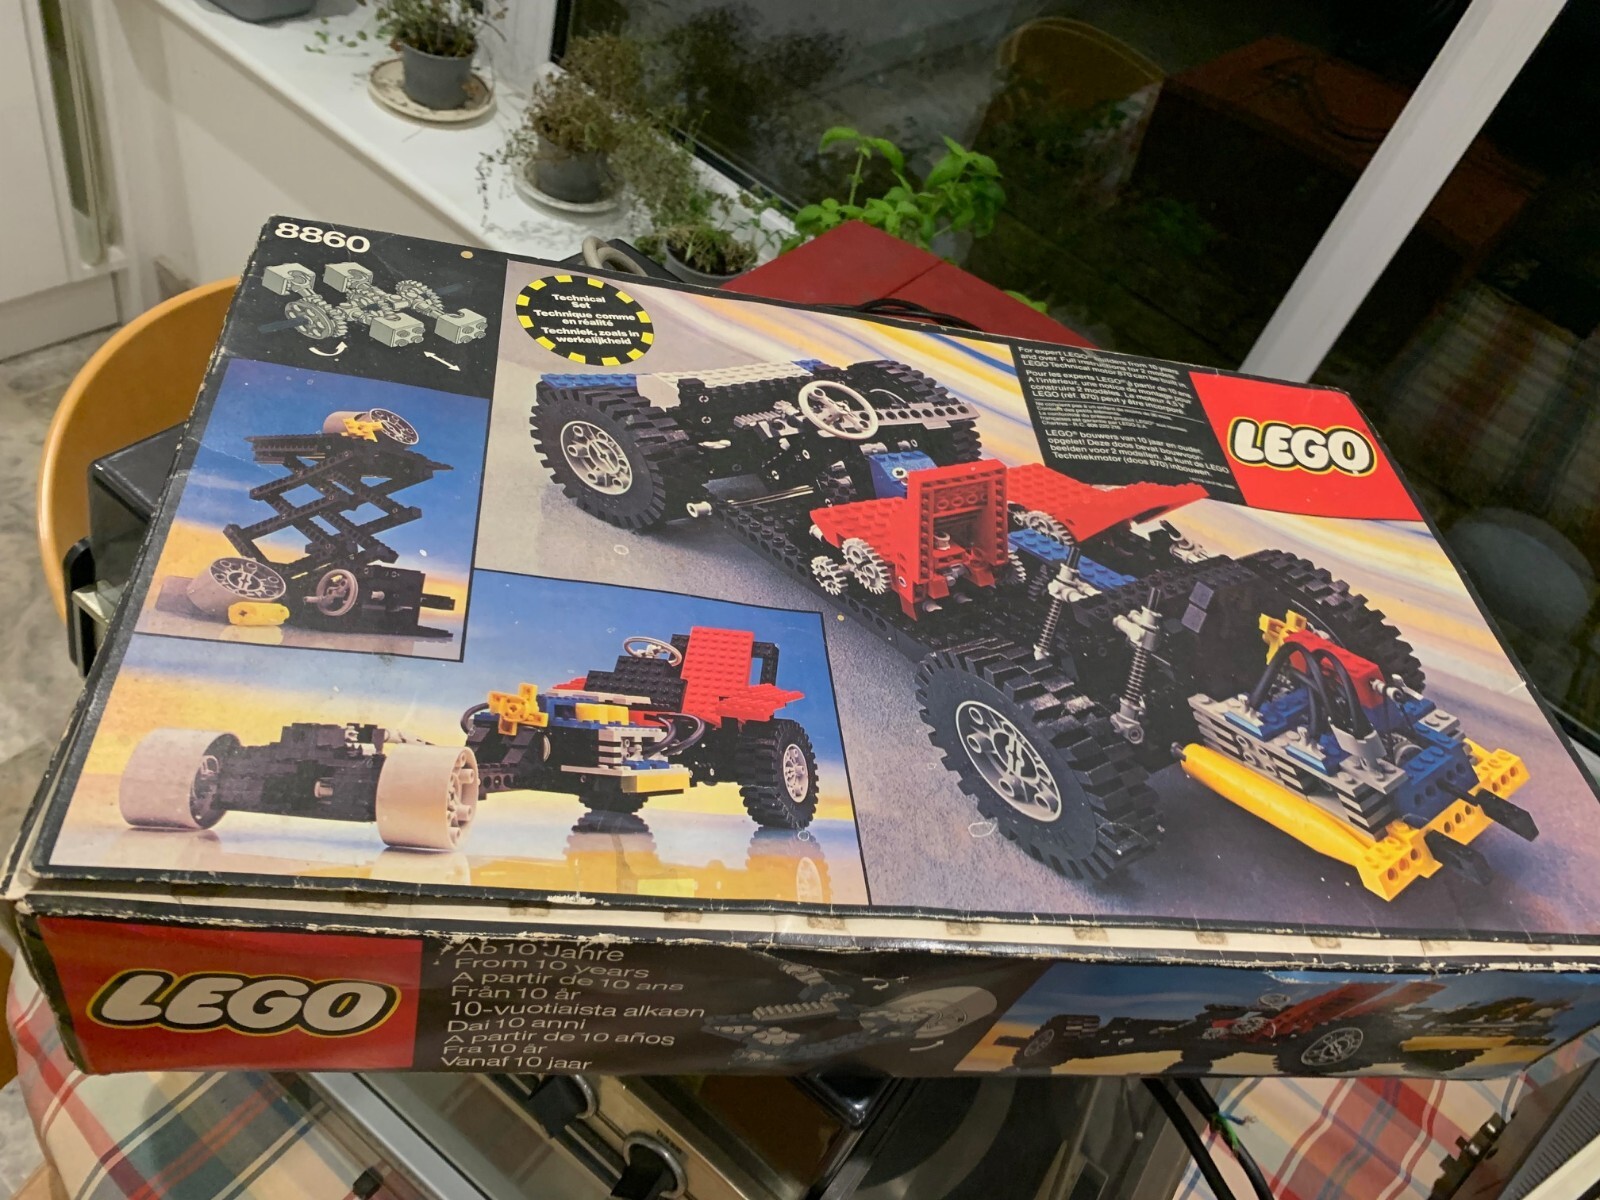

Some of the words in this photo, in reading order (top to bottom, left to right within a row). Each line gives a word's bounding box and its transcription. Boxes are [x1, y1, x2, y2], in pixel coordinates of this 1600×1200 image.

[275, 222, 370, 253] 8860
[552, 294, 606, 303] Technical
[533, 309, 592, 319] Technique
[541, 327, 597, 336] Techniek,
[556, 336, 632, 345] werkelijkheid
[1049, 362, 1090, 370] Technical
[1078, 360, 1126, 371] instructions
[1080, 393, 1099, 401] 870)
[1136, 394, 1164, 403] moteur
[1138, 389, 1173, 399] montage
[1079, 432, 1119, 440] bouwers
[1134, 443, 1158, 452] bevat
[1230, 418, 1375, 475] LEGO
[1050, 444, 1087, 452] beelden
[1174, 456, 1193, 466] kunt
[1206, 462, 1229, 474] LEGO
[1052, 452, 1121, 462] Techniekmotor
[1123, 457, 1149, 465] (doos
[1150, 459, 1169, 469] 870)
[456, 942, 497, 956] Ab
[504, 943, 537, 955] 10
[544, 944, 624, 962] Jahre
[454, 958, 528, 969] From
[537, 960, 567, 971] 10
[573, 964, 650, 978] years
[452, 972, 474, 982] A
[481, 972, 551, 986] partir
[560, 973, 593, 987] de
[600, 979, 630, 990] 10
[636, 981, 684, 992] ans
[452, 985, 510, 999] Från
[517, 988, 548, 1000] 10
[554, 988, 581, 1000] år
[92, 971, 397, 1035] LEGO
[451, 1002, 617, 1018] 10-vuotiaista
[623, 1005, 704, 1018] alkaen
[448, 1020, 490, 1032] Dai
[496, 1018, 524, 1029] 10
[531, 1018, 586, 1030] anni
[444, 1034, 465, 1044] A
[471, 1031, 537, 1044] partir
[544, 1031, 576, 1043] de
[581, 1032, 610, 1043] 10
[615, 1032, 675, 1047] años
[443, 1045, 481, 1054] Fra
[488, 1044, 517, 1054] 10
[522, 1043, 548, 1054] år
[440, 1056, 510, 1068] Vanaf
[516, 1056, 542, 1068] 10
[547, 1056, 592, 1071] jaar
